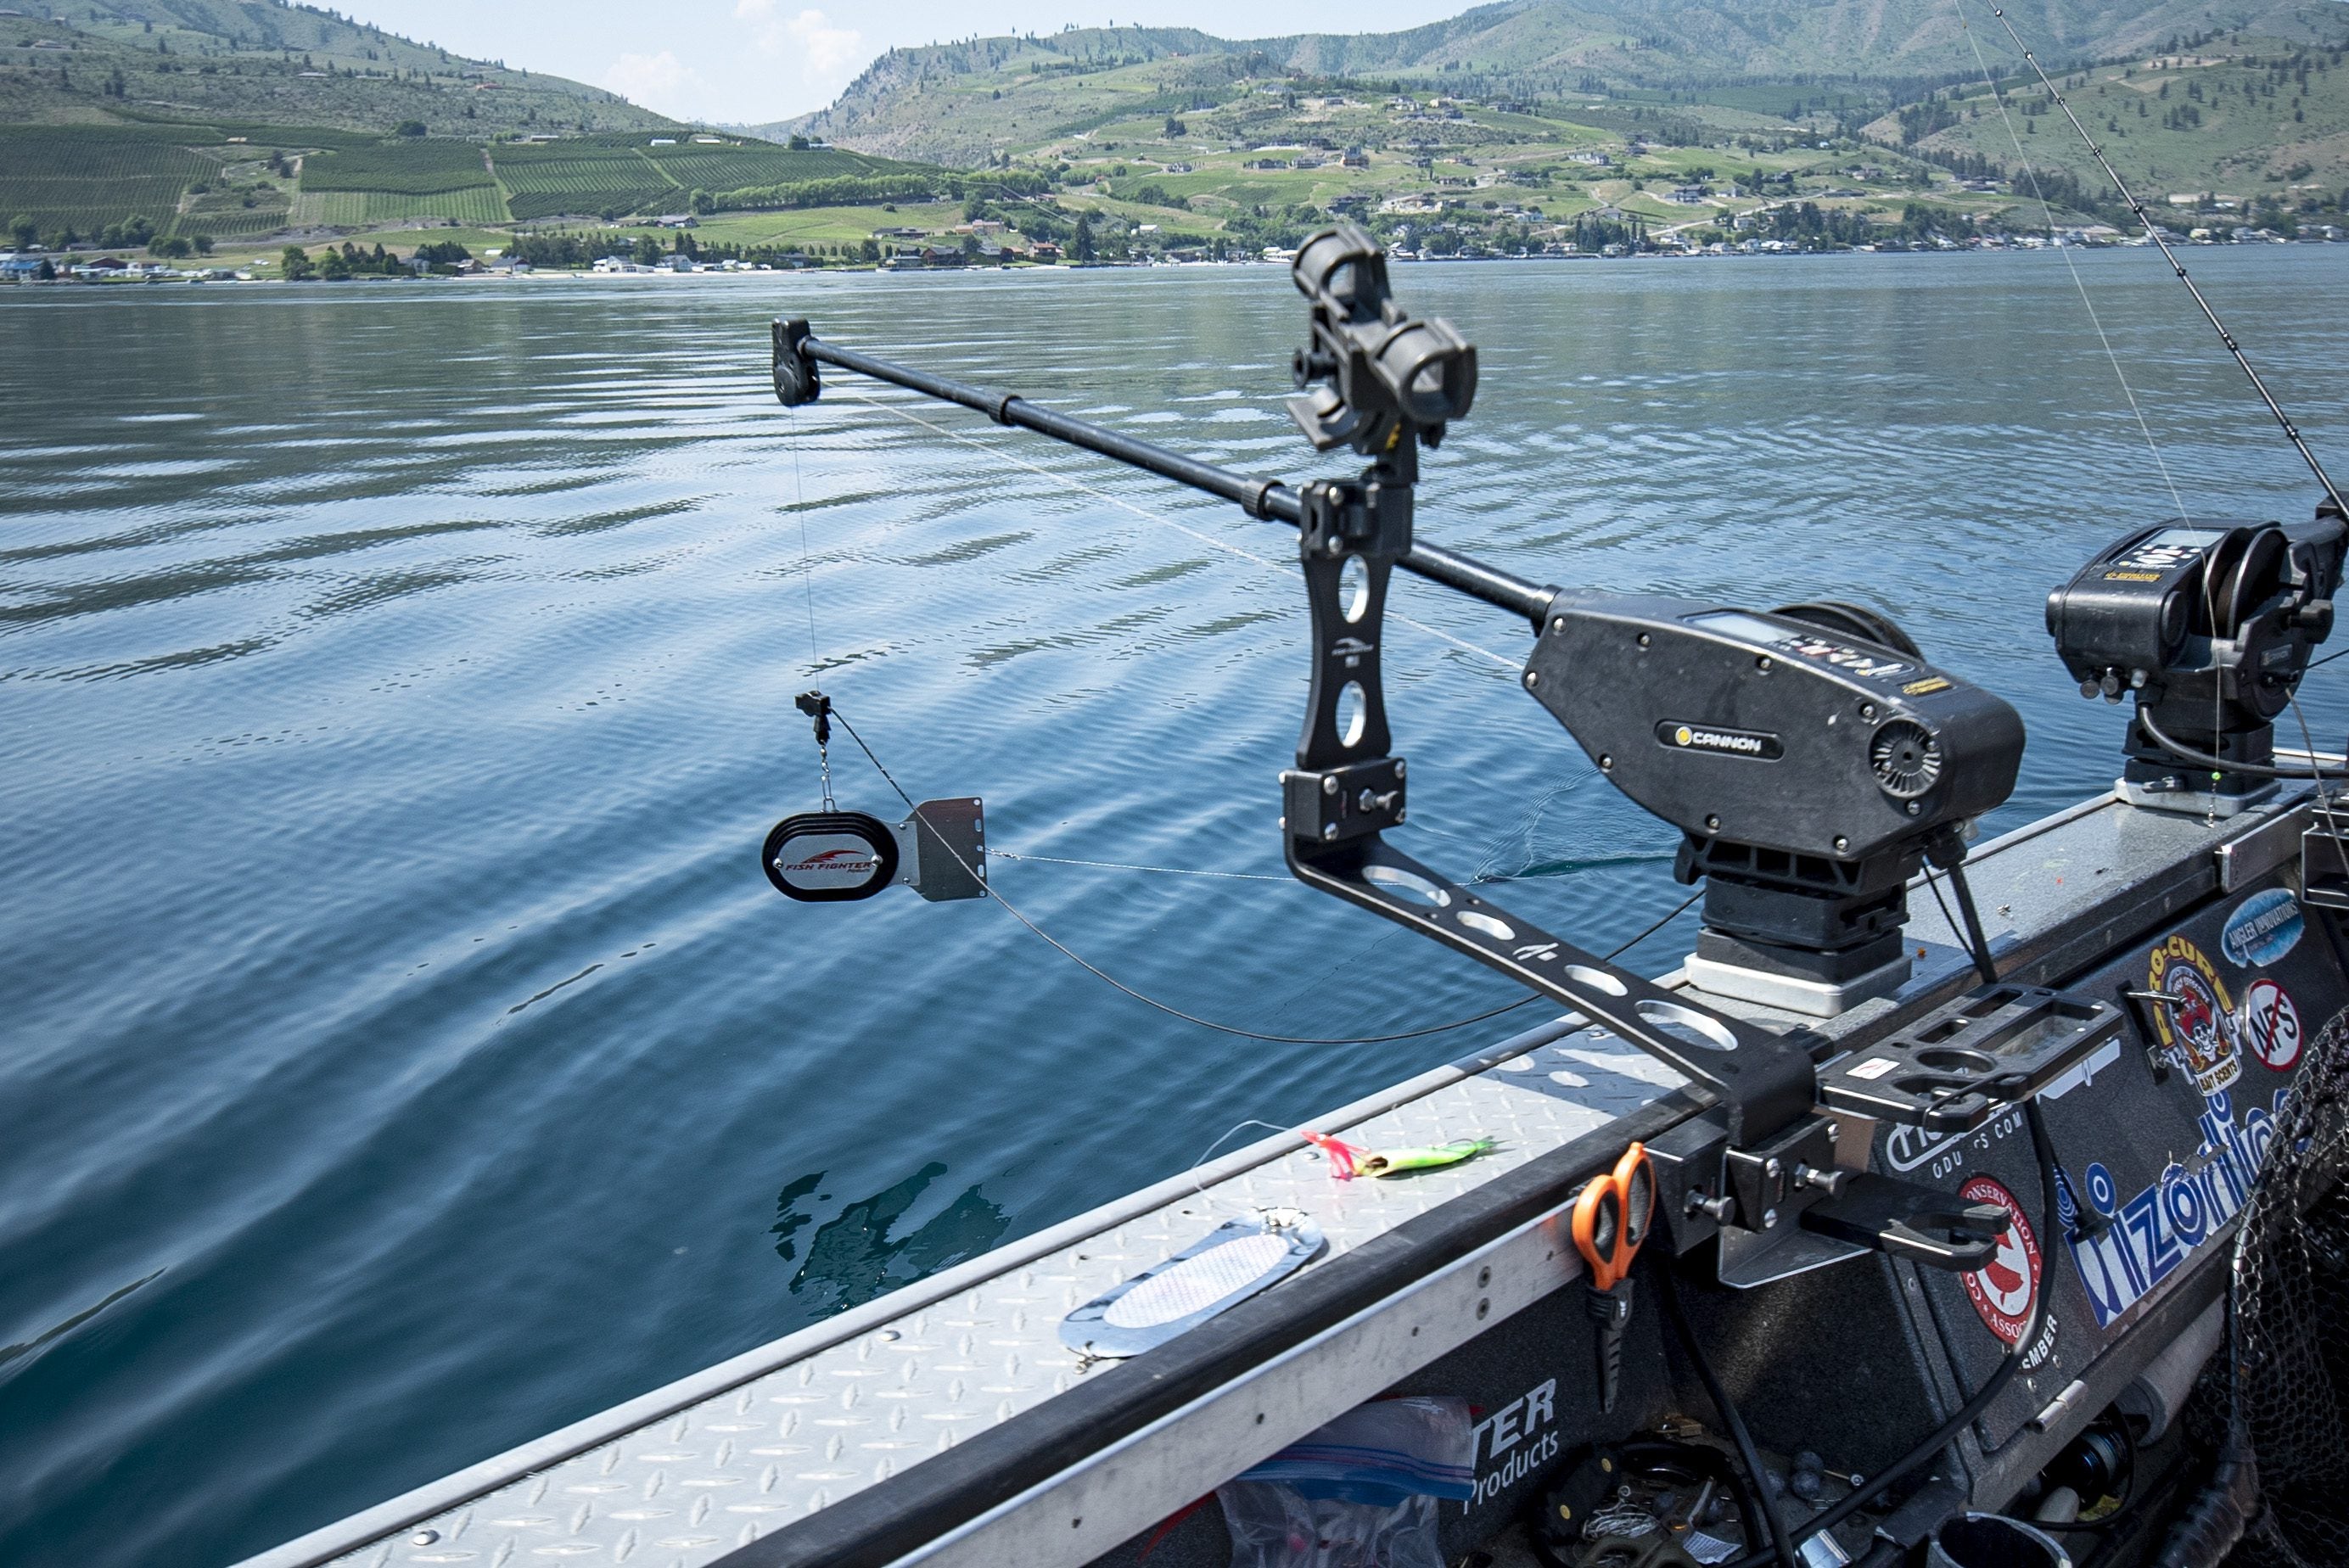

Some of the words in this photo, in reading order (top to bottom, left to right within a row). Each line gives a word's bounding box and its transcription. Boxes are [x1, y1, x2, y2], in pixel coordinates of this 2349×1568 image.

[1692, 731, 1762, 752] CANNON
[2250, 997, 2297, 1058] NFS
[2200, 1076, 2216, 1091] BAIT
[2214, 1059, 2239, 1085] SCENTS
[1965, 1184, 2037, 1254] ONSERVATION
[2002, 1313, 2058, 1370] EMBER
